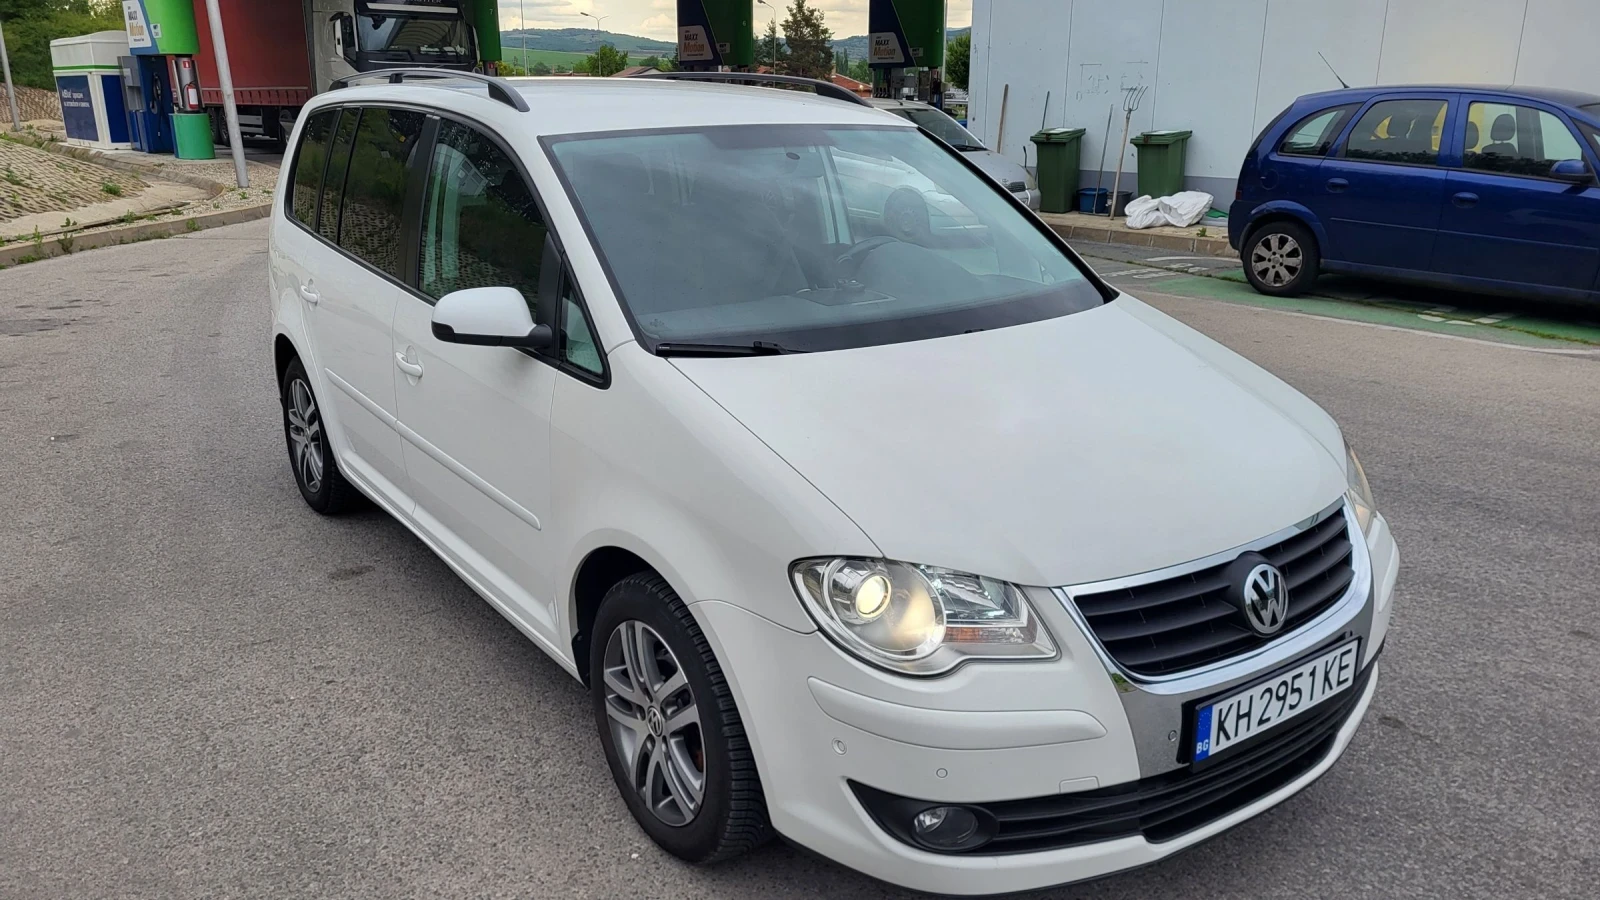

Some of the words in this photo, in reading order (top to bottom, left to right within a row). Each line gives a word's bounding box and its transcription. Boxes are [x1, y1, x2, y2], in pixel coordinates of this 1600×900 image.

[684, 33, 699, 41] MAXX
[683, 41, 705, 53] Motion
[873, 46, 896, 56] Motion
[1196, 739, 1209, 754] BG
